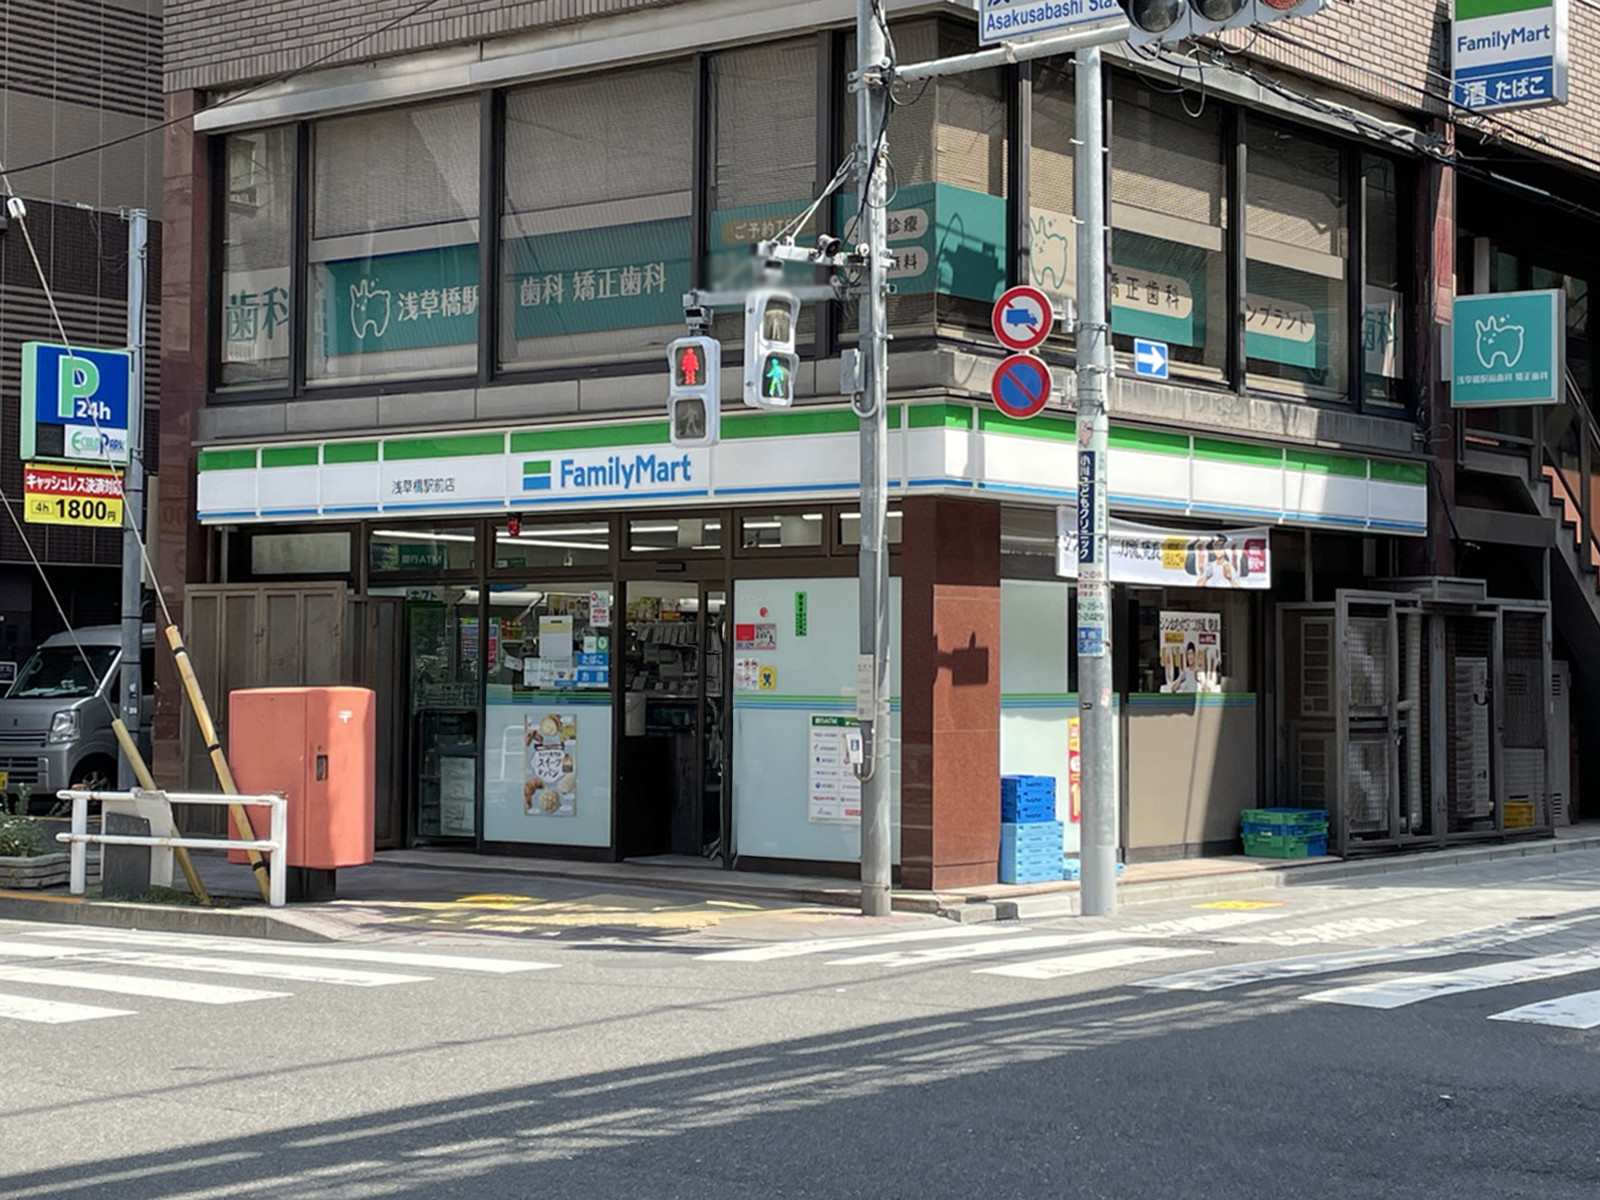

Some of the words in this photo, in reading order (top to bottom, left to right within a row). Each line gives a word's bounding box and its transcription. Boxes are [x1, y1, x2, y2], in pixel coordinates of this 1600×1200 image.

[986, 0, 1083, 31] Asakusabashi
[1457, 24, 1551, 53] FamilyMart
[1463, 80, 1487, 107] 酒
[1495, 76, 1545, 99] たばこ
[519, 273, 565, 307] 歯科
[573, 262, 668, 301] 矯正歯科
[58, 354, 100, 418] P
[76, 400, 111, 420] 24h
[561, 454, 691, 489] FamilyMart
